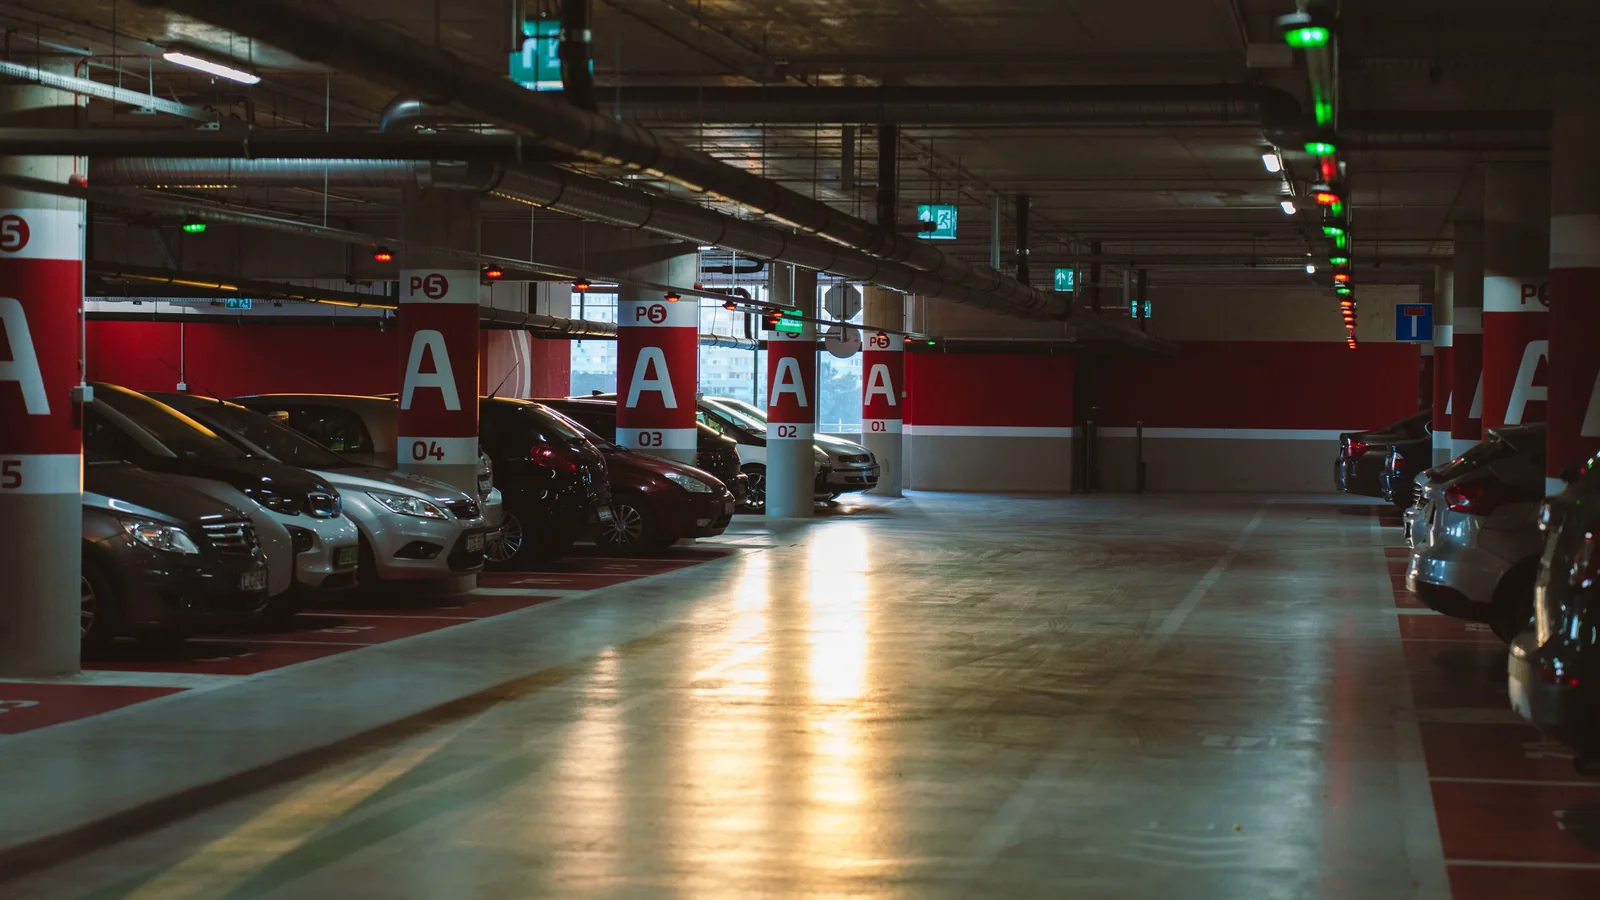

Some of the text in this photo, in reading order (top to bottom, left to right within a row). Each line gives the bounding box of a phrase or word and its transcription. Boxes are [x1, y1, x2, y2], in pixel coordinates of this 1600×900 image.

[410, 273, 448, 299] P5
[1521, 284, 1548, 306] P
[636, 304, 667, 324] P5
[870, 333, 890, 349] P5
[401, 330, 461, 411] A
[626, 347, 677, 408] A
[770, 357, 808, 407] A
[864, 364, 896, 406] A
[1504, 340, 1548, 425] A
[778, 426, 797, 438] 02
[871, 421, 887, 432] 01
[639, 432, 662, 447] 03
[412, 441, 444, 461] 04
